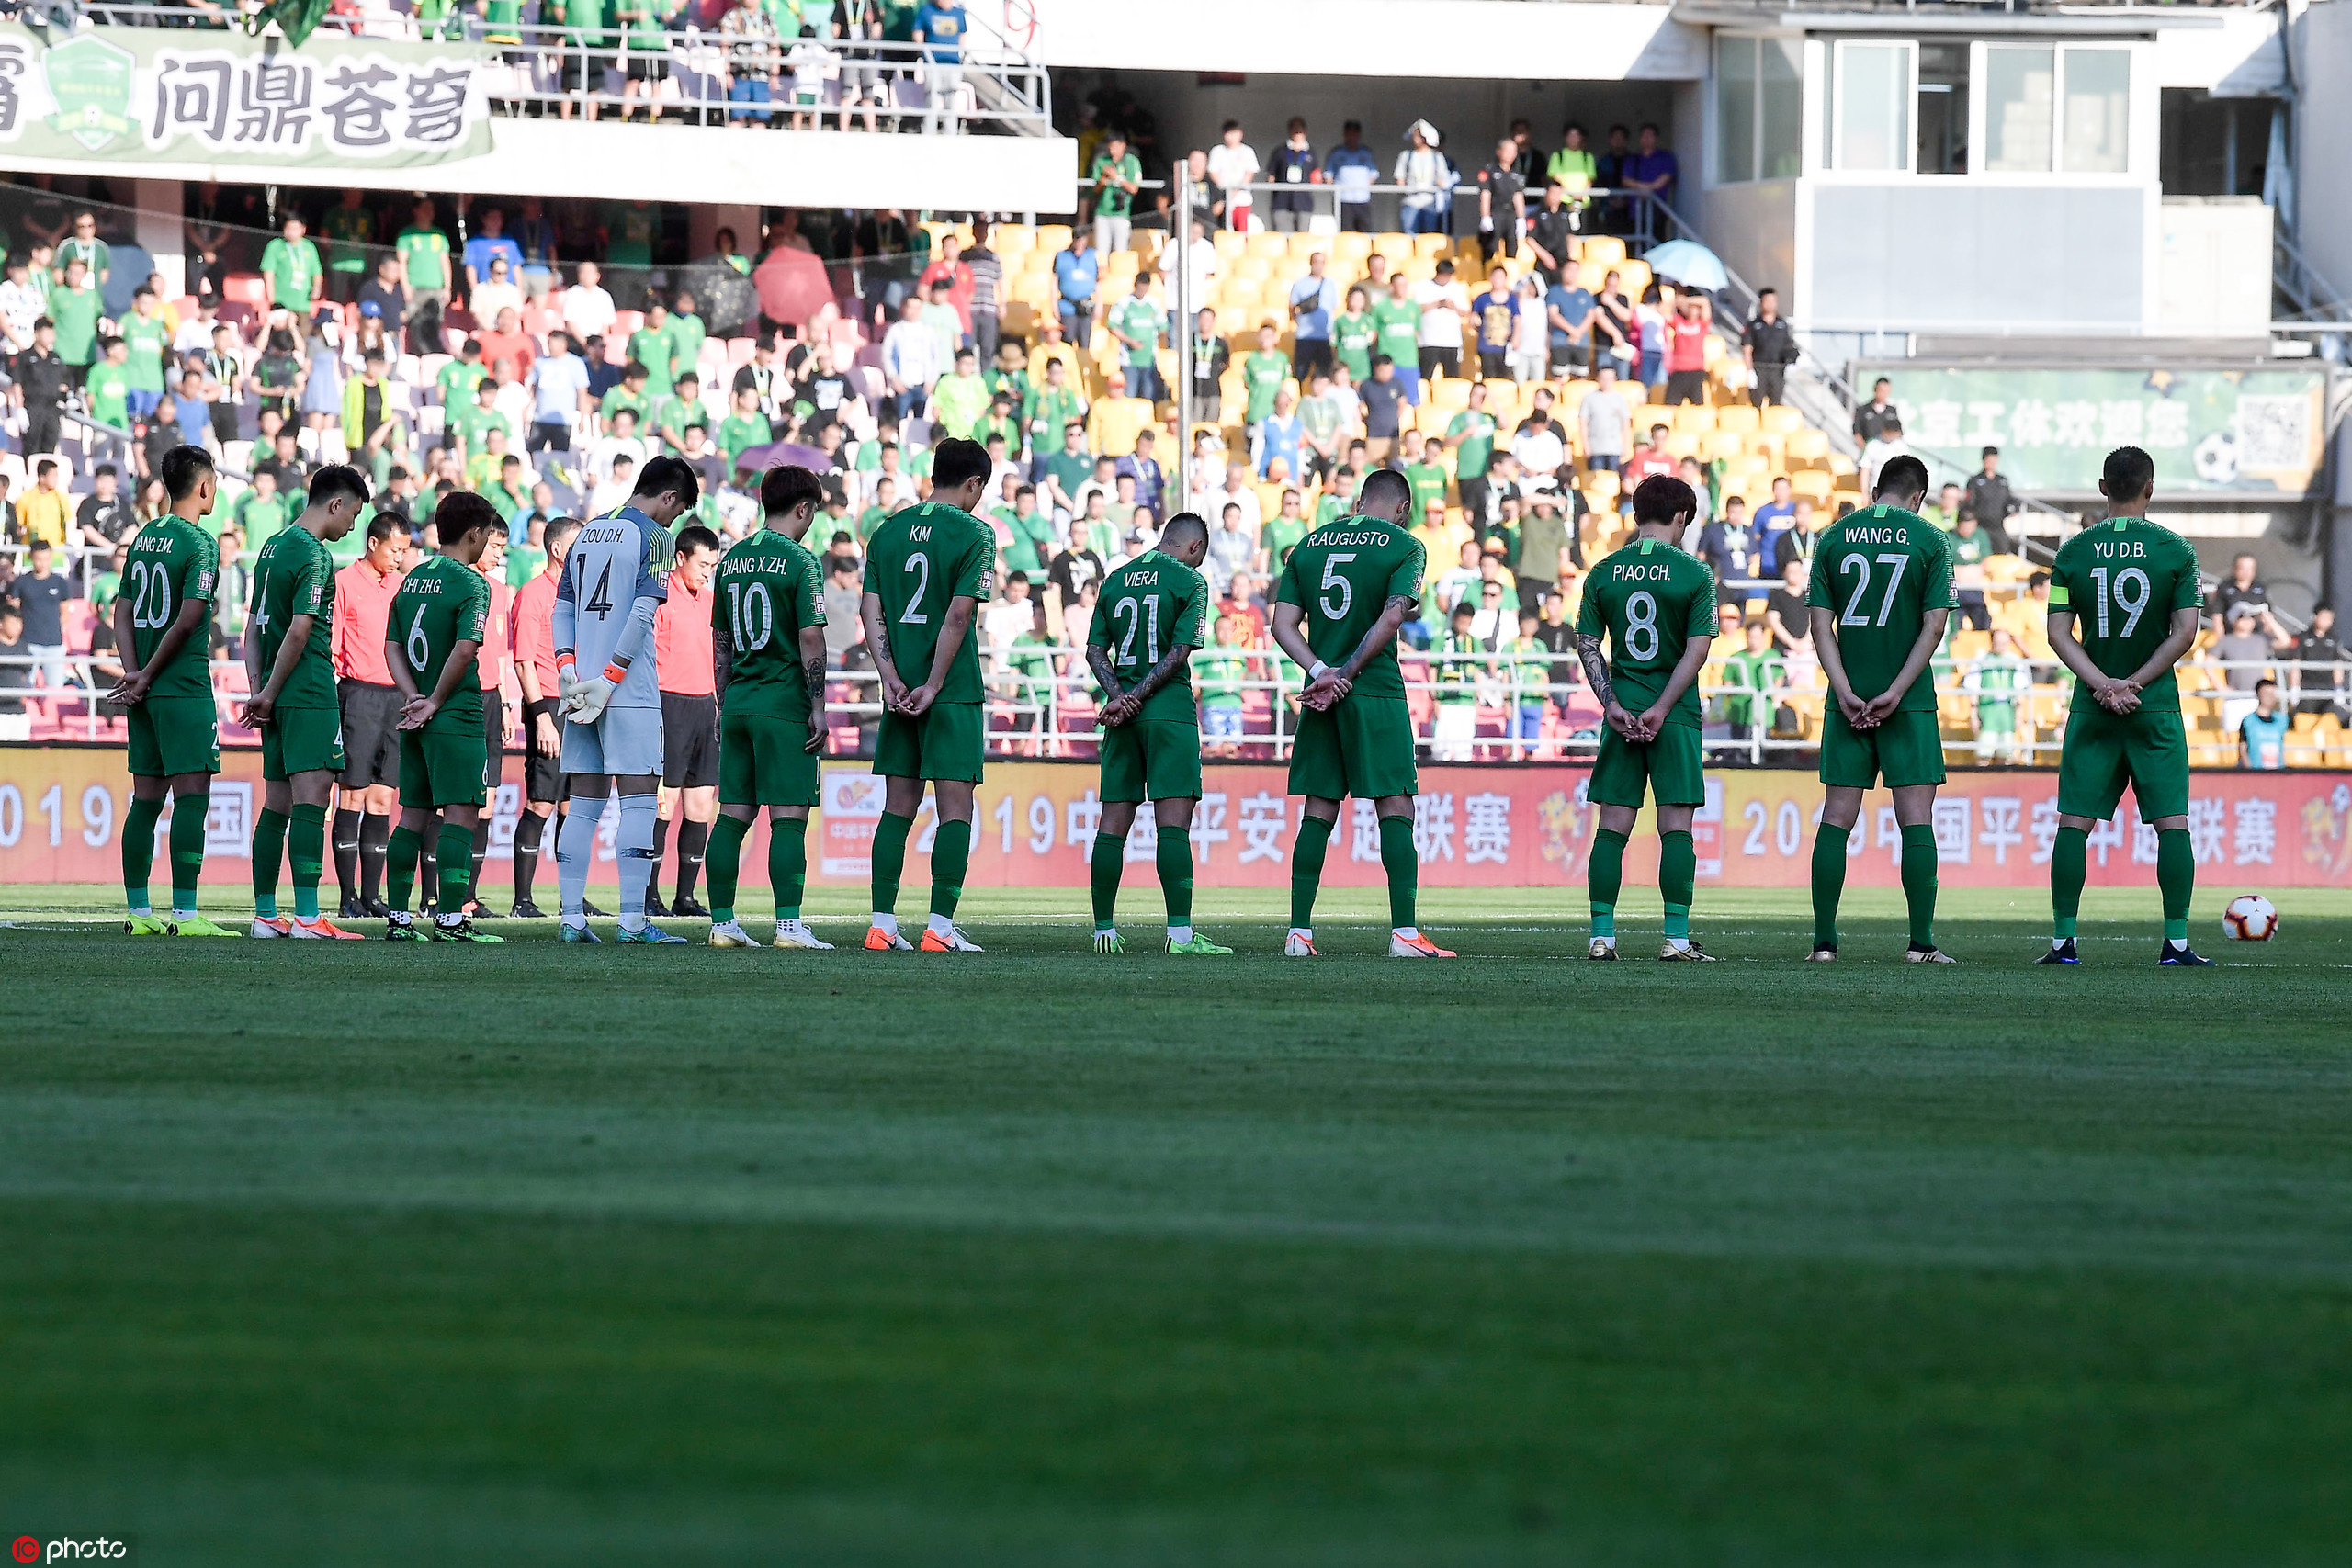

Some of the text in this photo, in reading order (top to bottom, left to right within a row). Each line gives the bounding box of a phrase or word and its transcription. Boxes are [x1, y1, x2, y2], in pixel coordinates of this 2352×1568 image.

[153, 58, 471, 146] 问鼎苍穹
[582, 528, 624, 543] ZOU D.H.
[721, 556, 786, 578] ZHANG X.ZH.
[909, 525, 933, 542] KIM
[1307, 531, 1390, 547] R.AUGUSTO
[1845, 527, 1910, 546] WANG G.
[2093, 542, 2147, 558] YU D.B.
[130, 560, 171, 629] 20
[256, 567, 271, 634] 4
[402, 578, 443, 594] CHI ZH.G.
[576, 553, 614, 622] 14
[899, 552, 929, 624] 2
[1125, 571, 1159, 587] VIERA
[1319, 553, 1357, 620] 5
[1612, 565, 1671, 581] PIAO CH.
[1839, 553, 1910, 626] 27
[2089, 567, 2151, 638] 19
[407, 603, 429, 671] 6
[727, 582, 772, 651] 10
[1114, 594, 1159, 666] 21
[1624, 591, 1659, 661] 8
